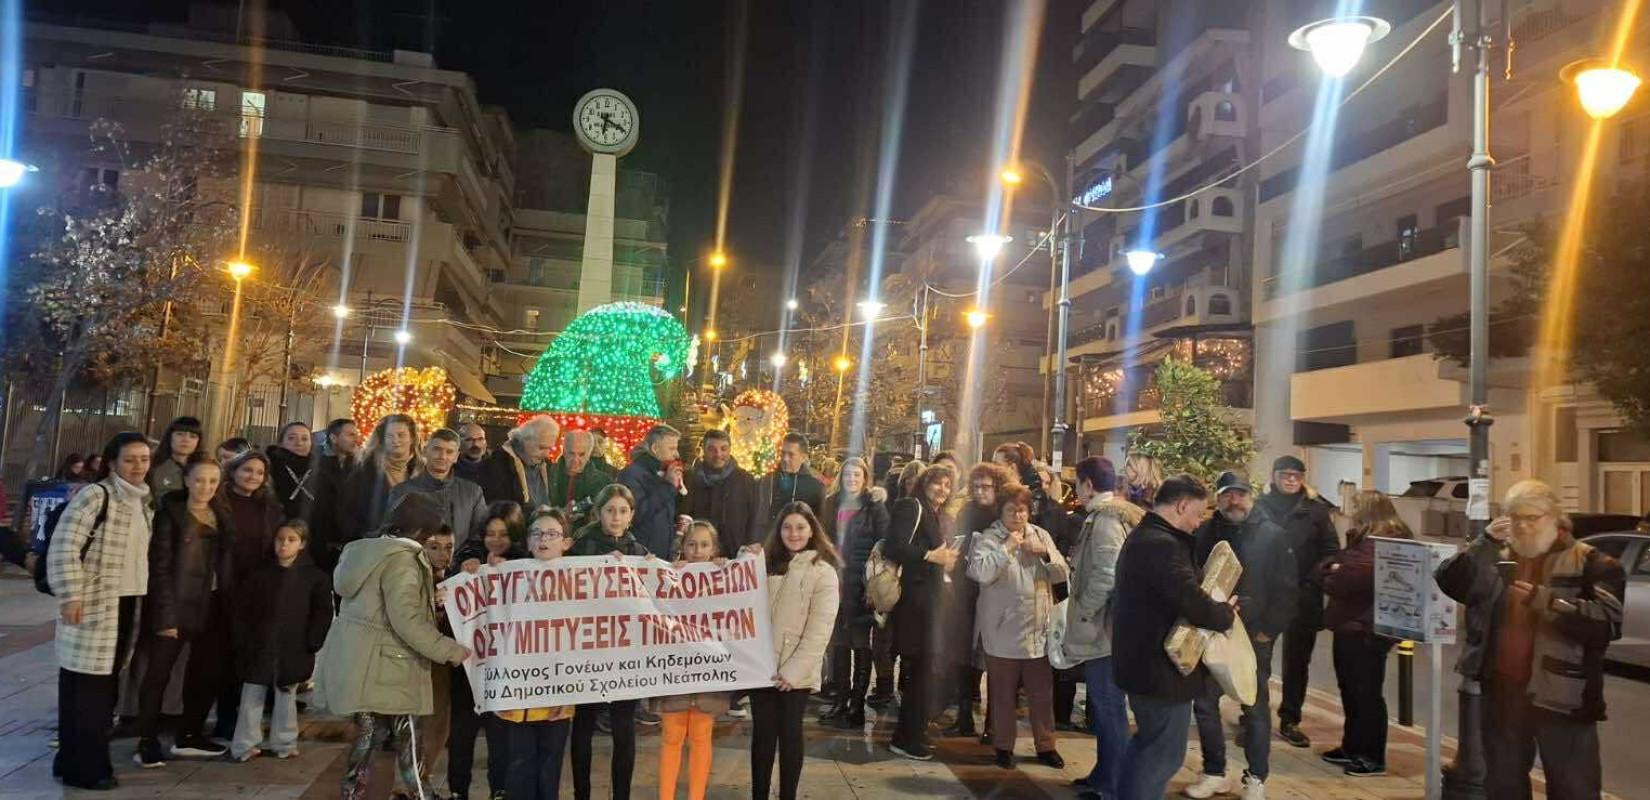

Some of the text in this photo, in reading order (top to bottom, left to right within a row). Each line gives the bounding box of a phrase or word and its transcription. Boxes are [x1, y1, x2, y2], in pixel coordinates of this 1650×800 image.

[487, 566, 649, 605] ΣΥΓΧΩΝΕΥΣΕΙΣ
[656, 560, 758, 599] ΣΧΟΛΕΙΩΝ
[488, 614, 631, 656] ΣΥΜΠΤΥΞΕΙΣ
[638, 607, 756, 646] ΤΜΗΜΑΤΩΝ
[484, 653, 732, 681] ύλλογος Γονέων και Κηδεμόνων
[501, 680, 584, 699] Δημοτικού
[590, 674, 657, 692] Σχολείου
[663, 669, 737, 685] Νεάπολης
